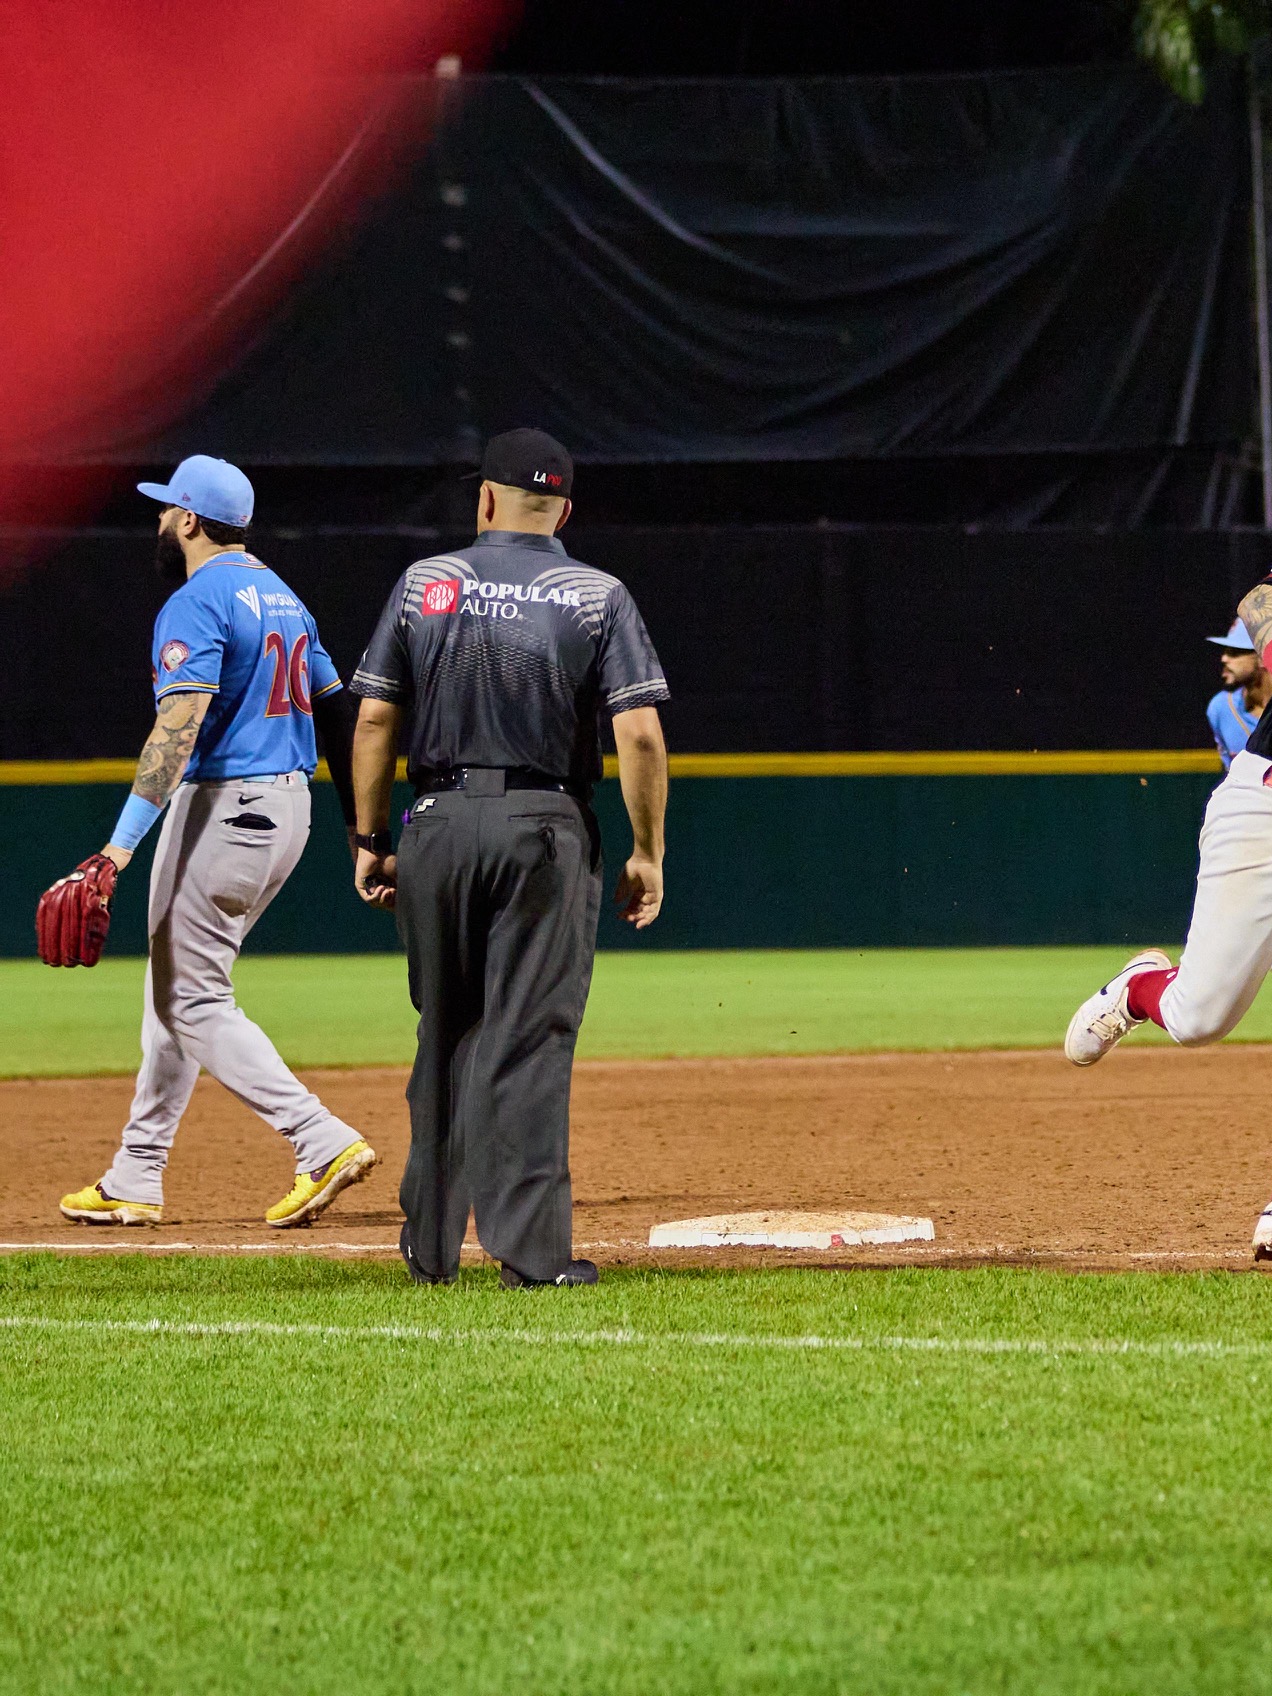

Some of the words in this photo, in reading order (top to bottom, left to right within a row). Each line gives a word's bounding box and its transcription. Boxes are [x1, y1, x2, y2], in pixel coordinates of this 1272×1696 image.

[462, 579, 581, 607] POPULAR
[460, 598, 519, 620] AUTO
[264, 631, 313, 718] 26
